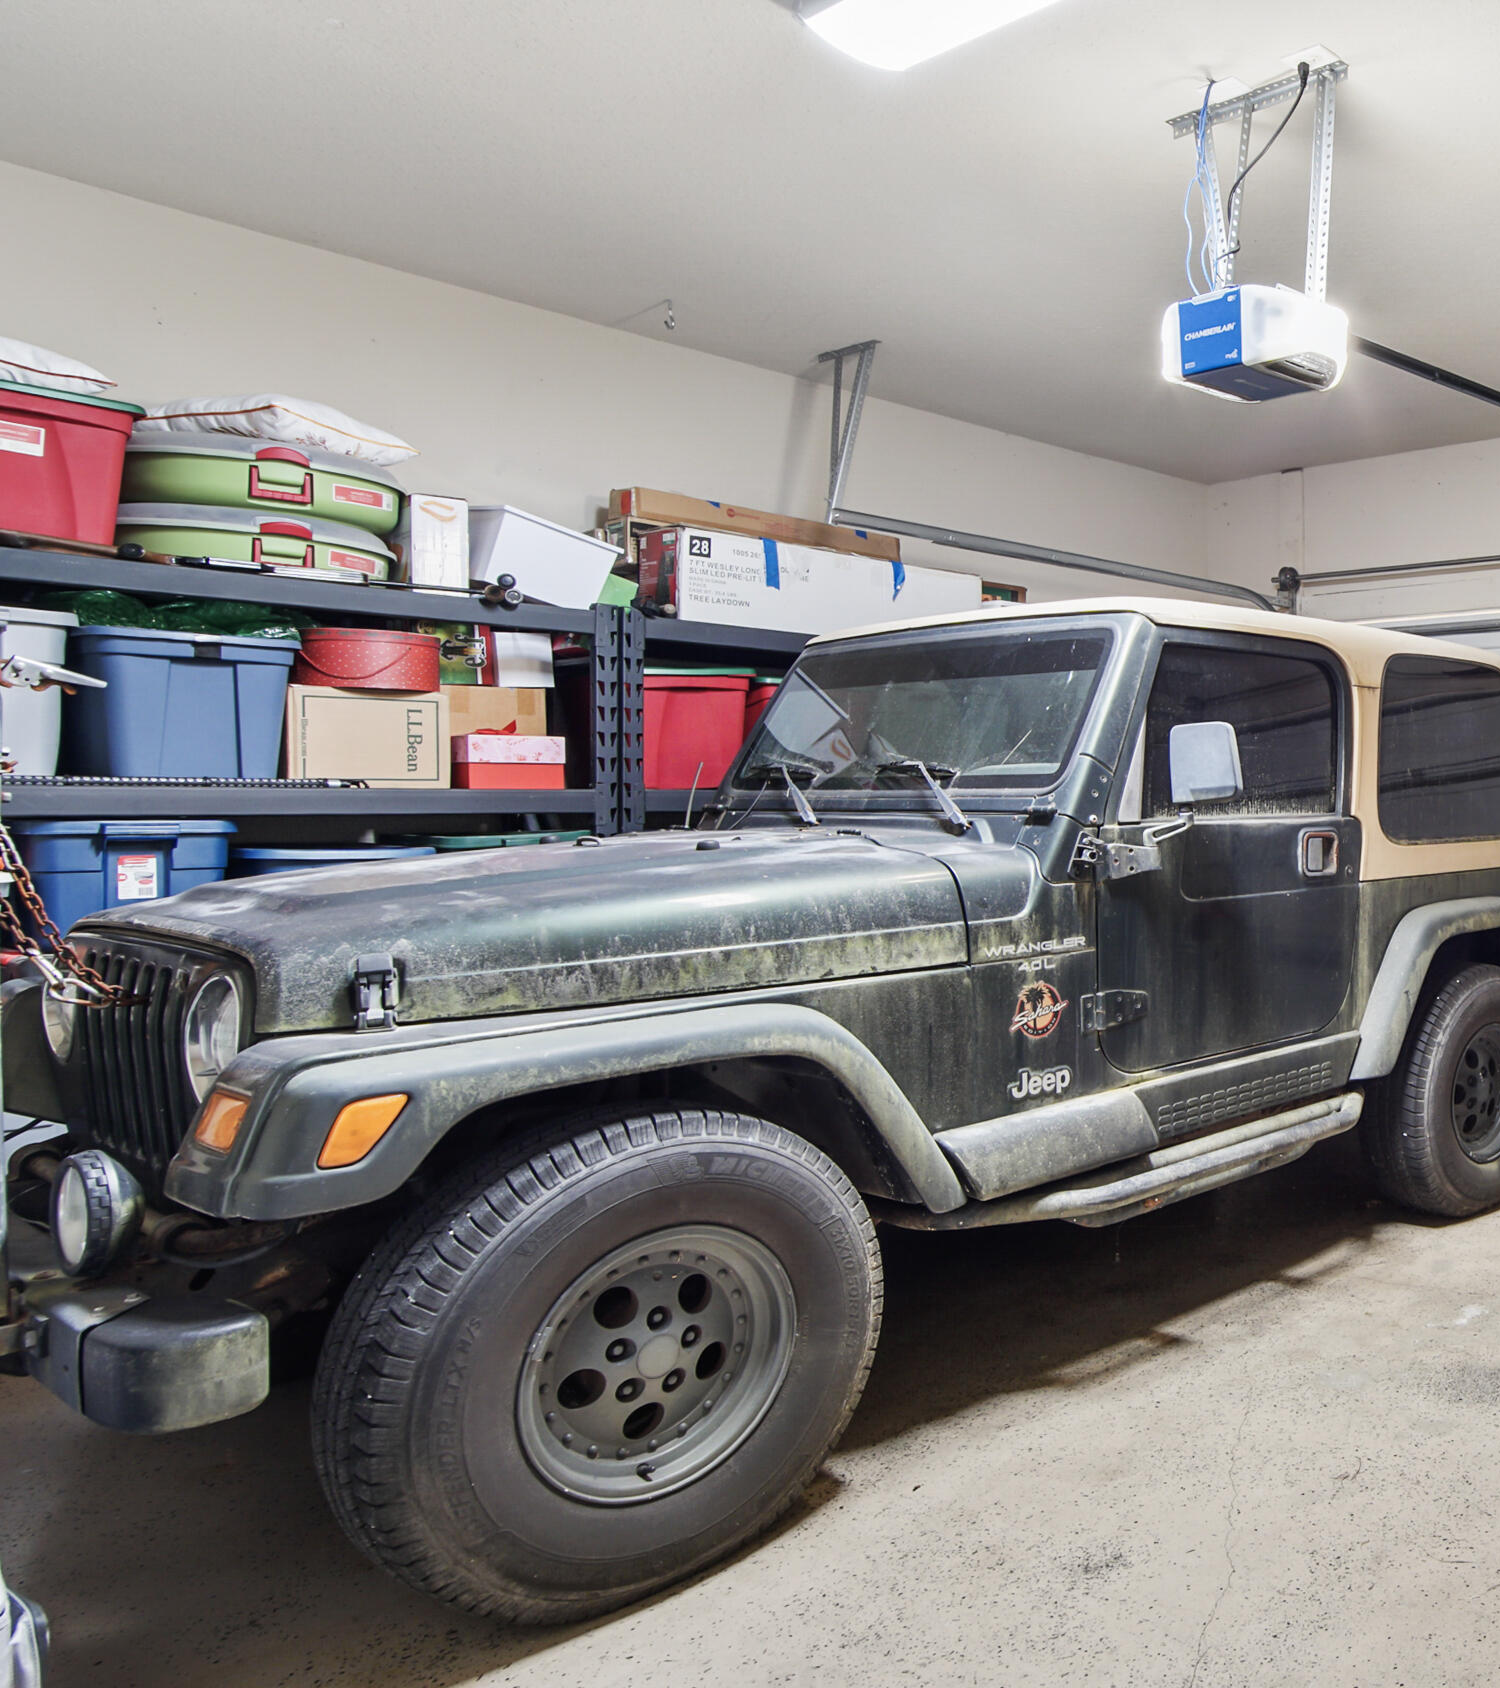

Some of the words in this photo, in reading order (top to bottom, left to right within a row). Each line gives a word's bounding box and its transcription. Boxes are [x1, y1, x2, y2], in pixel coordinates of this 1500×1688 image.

[1184, 323, 1236, 341] CHAMBERLAIN
[691, 538, 710, 555] 28
[689, 567, 709, 576] SLIM
[710, 569, 725, 578] LED
[727, 572, 756, 582] PRE-LIT
[695, 560, 704, 568] FT
[707, 562, 739, 573] WESLEY
[689, 594, 710, 604] TREE
[711, 597, 750, 608] LAYDOWN
[406, 709, 423, 772] L.L.Bean
[985, 936, 1087, 957] WRANGLER
[1011, 1002, 1067, 1031] Sahara
[1010, 1068, 1071, 1099] Jeep
[710, 1156, 832, 1223] MICHELIN
[442, 1362, 467, 1408] LTX
